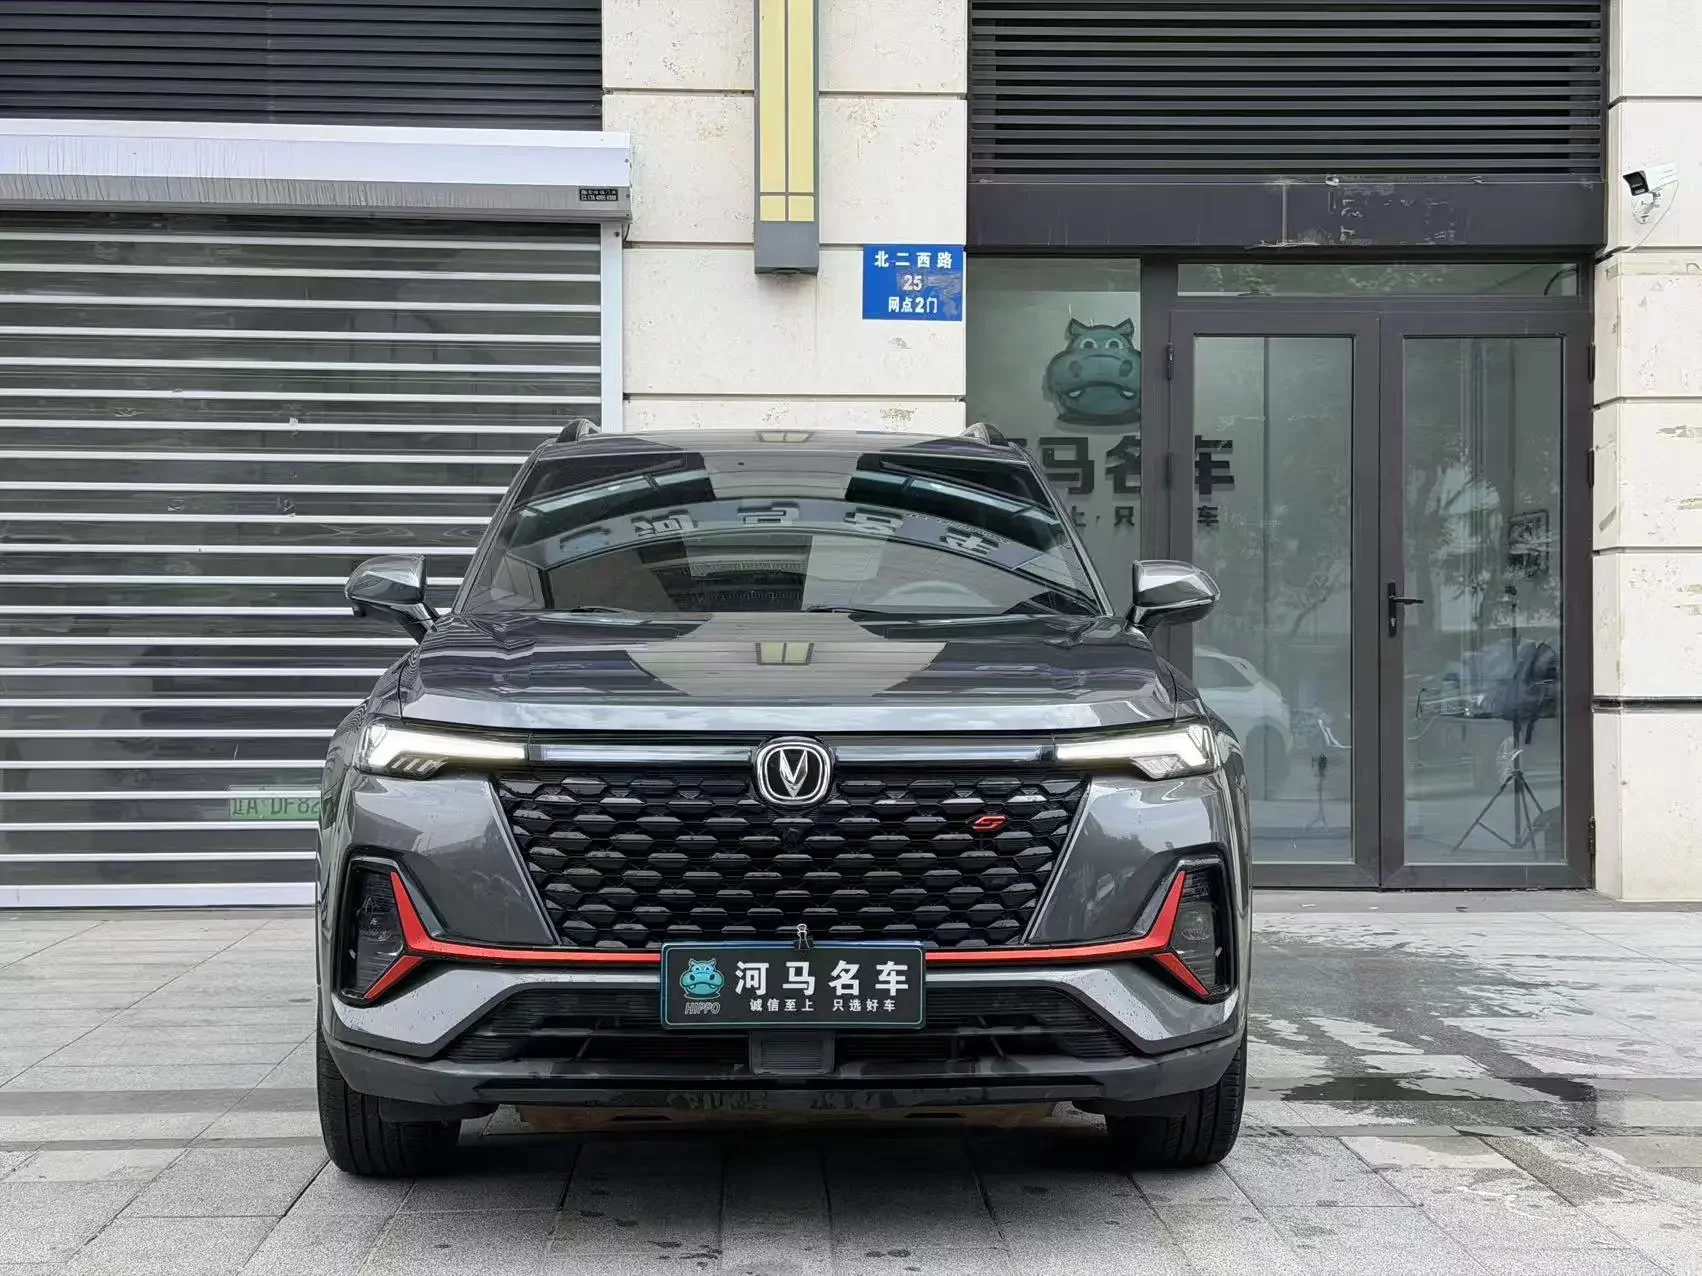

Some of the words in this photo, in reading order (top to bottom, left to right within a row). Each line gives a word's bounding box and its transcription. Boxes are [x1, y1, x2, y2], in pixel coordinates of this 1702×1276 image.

[874, 250, 952, 269] 北二西路
[903, 274, 923, 291] 25
[888, 296, 938, 314] 网点2门
[734, 959, 909, 997] 河马名车
[685, 1002, 721, 1015] HIPPO
[750, 999, 815, 1013] 诚信至上
[832, 999, 897, 1013] 只选好车
